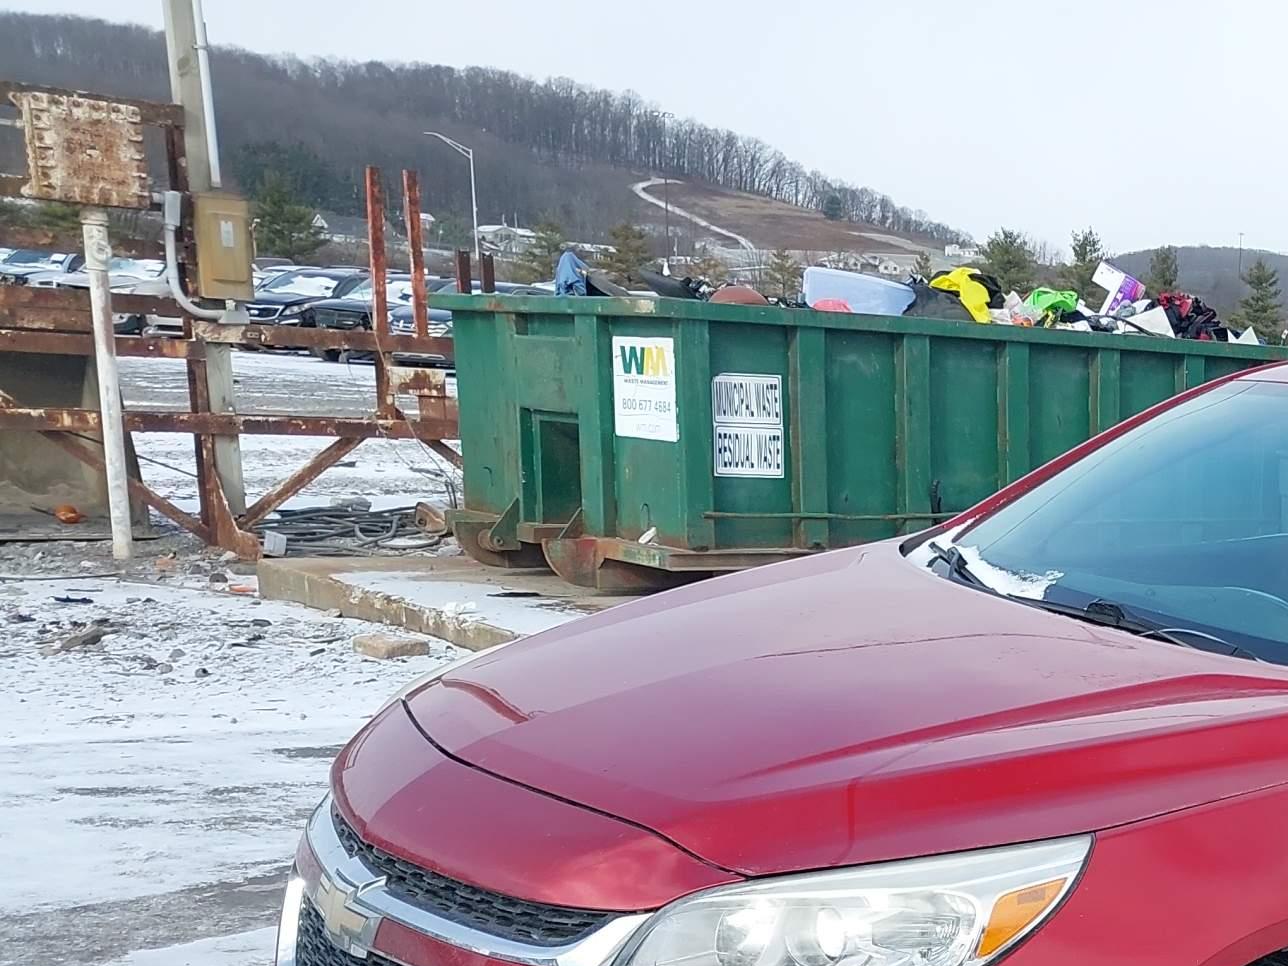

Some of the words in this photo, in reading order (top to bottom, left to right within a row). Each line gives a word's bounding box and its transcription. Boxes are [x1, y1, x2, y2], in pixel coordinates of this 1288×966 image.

[620, 345, 669, 376] WM
[622, 398, 637, 410] 800
[639, 399, 652, 411] 677
[715, 381, 754, 417] MUNICIPAL
[755, 383, 779, 418] WASTE
[718, 432, 755, 468] RESIDUAL
[756, 434, 780, 469] WASTE
